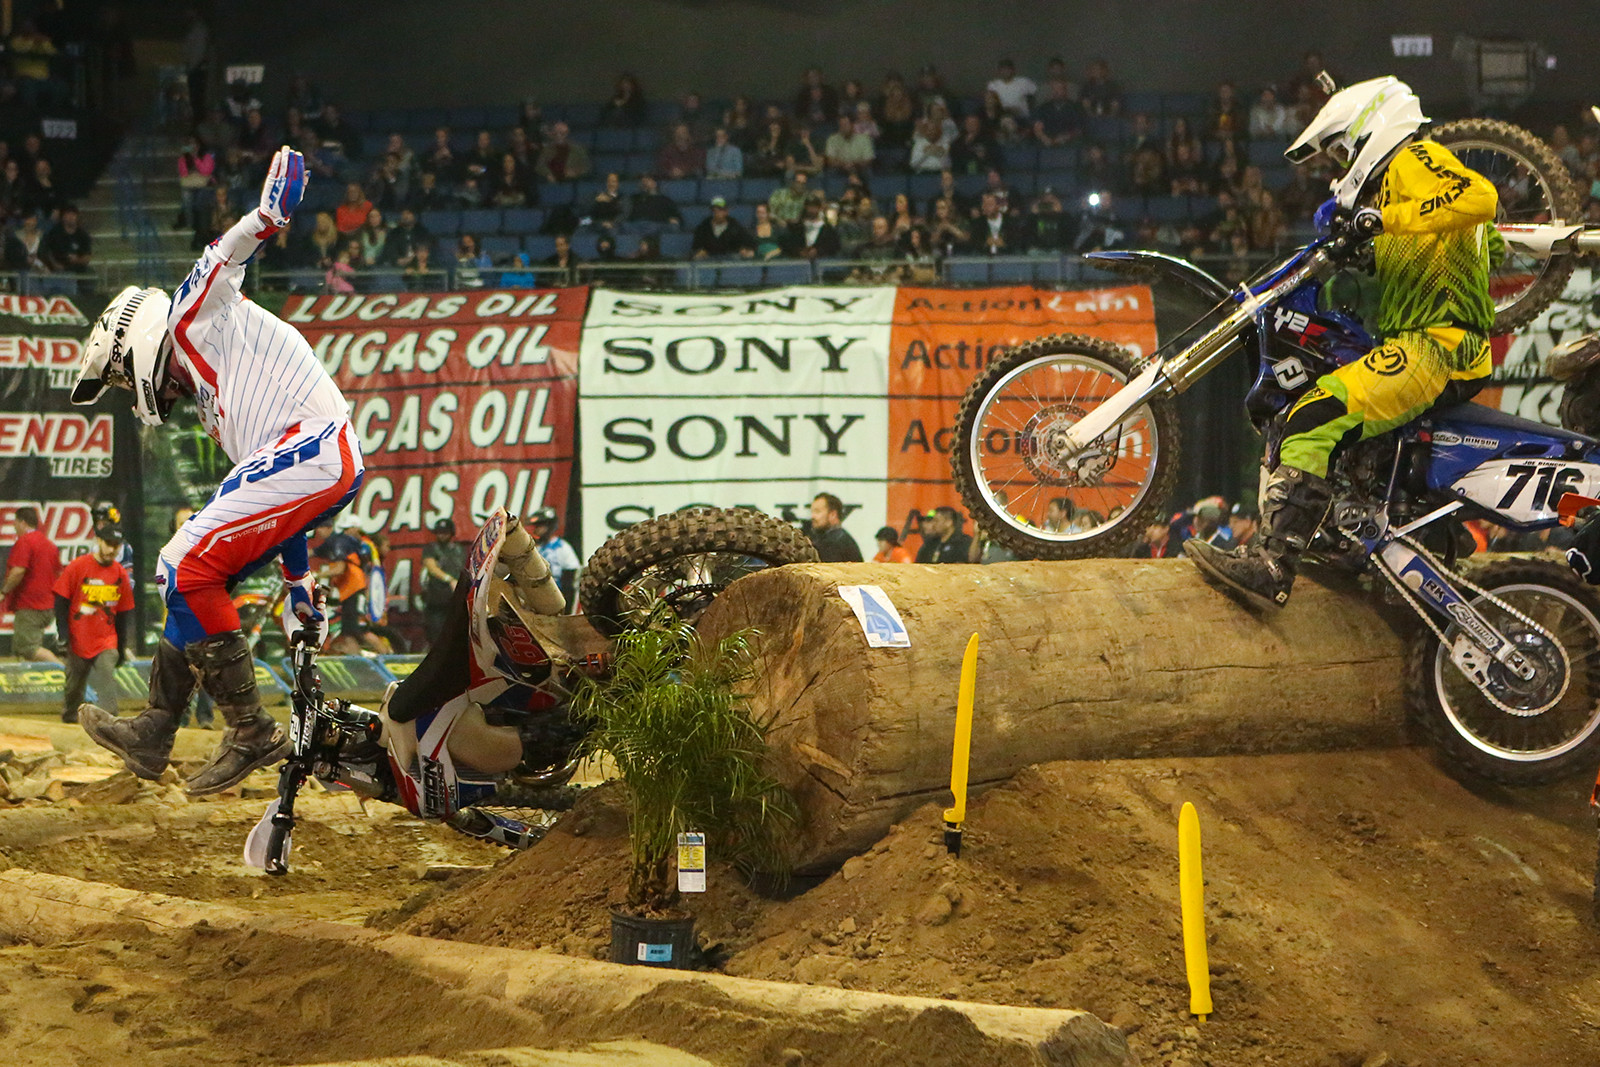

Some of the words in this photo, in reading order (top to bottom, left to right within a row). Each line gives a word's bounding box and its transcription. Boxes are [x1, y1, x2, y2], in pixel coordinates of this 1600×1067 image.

[288, 295, 468, 323] LUCAS
[475, 292, 559, 318] OIL
[611, 294, 874, 318] SONY
[0, 338, 87, 365] END
[111, 338, 123, 364] SPY
[311, 328, 458, 379] UCAS
[466, 324, 550, 370] OIL
[602, 334, 868, 376] SONY
[901, 338, 1013, 371] Actio
[0, 417, 113, 455] ENDA
[349, 391, 459, 456] CAS
[469, 388, 554, 450] OIL
[602, 414, 866, 464] SONY
[51, 457, 113, 477] TIRES
[355, 471, 460, 535] CAS
[1495, 464, 1585, 513] 716
[1424, 580, 1446, 602] RK
